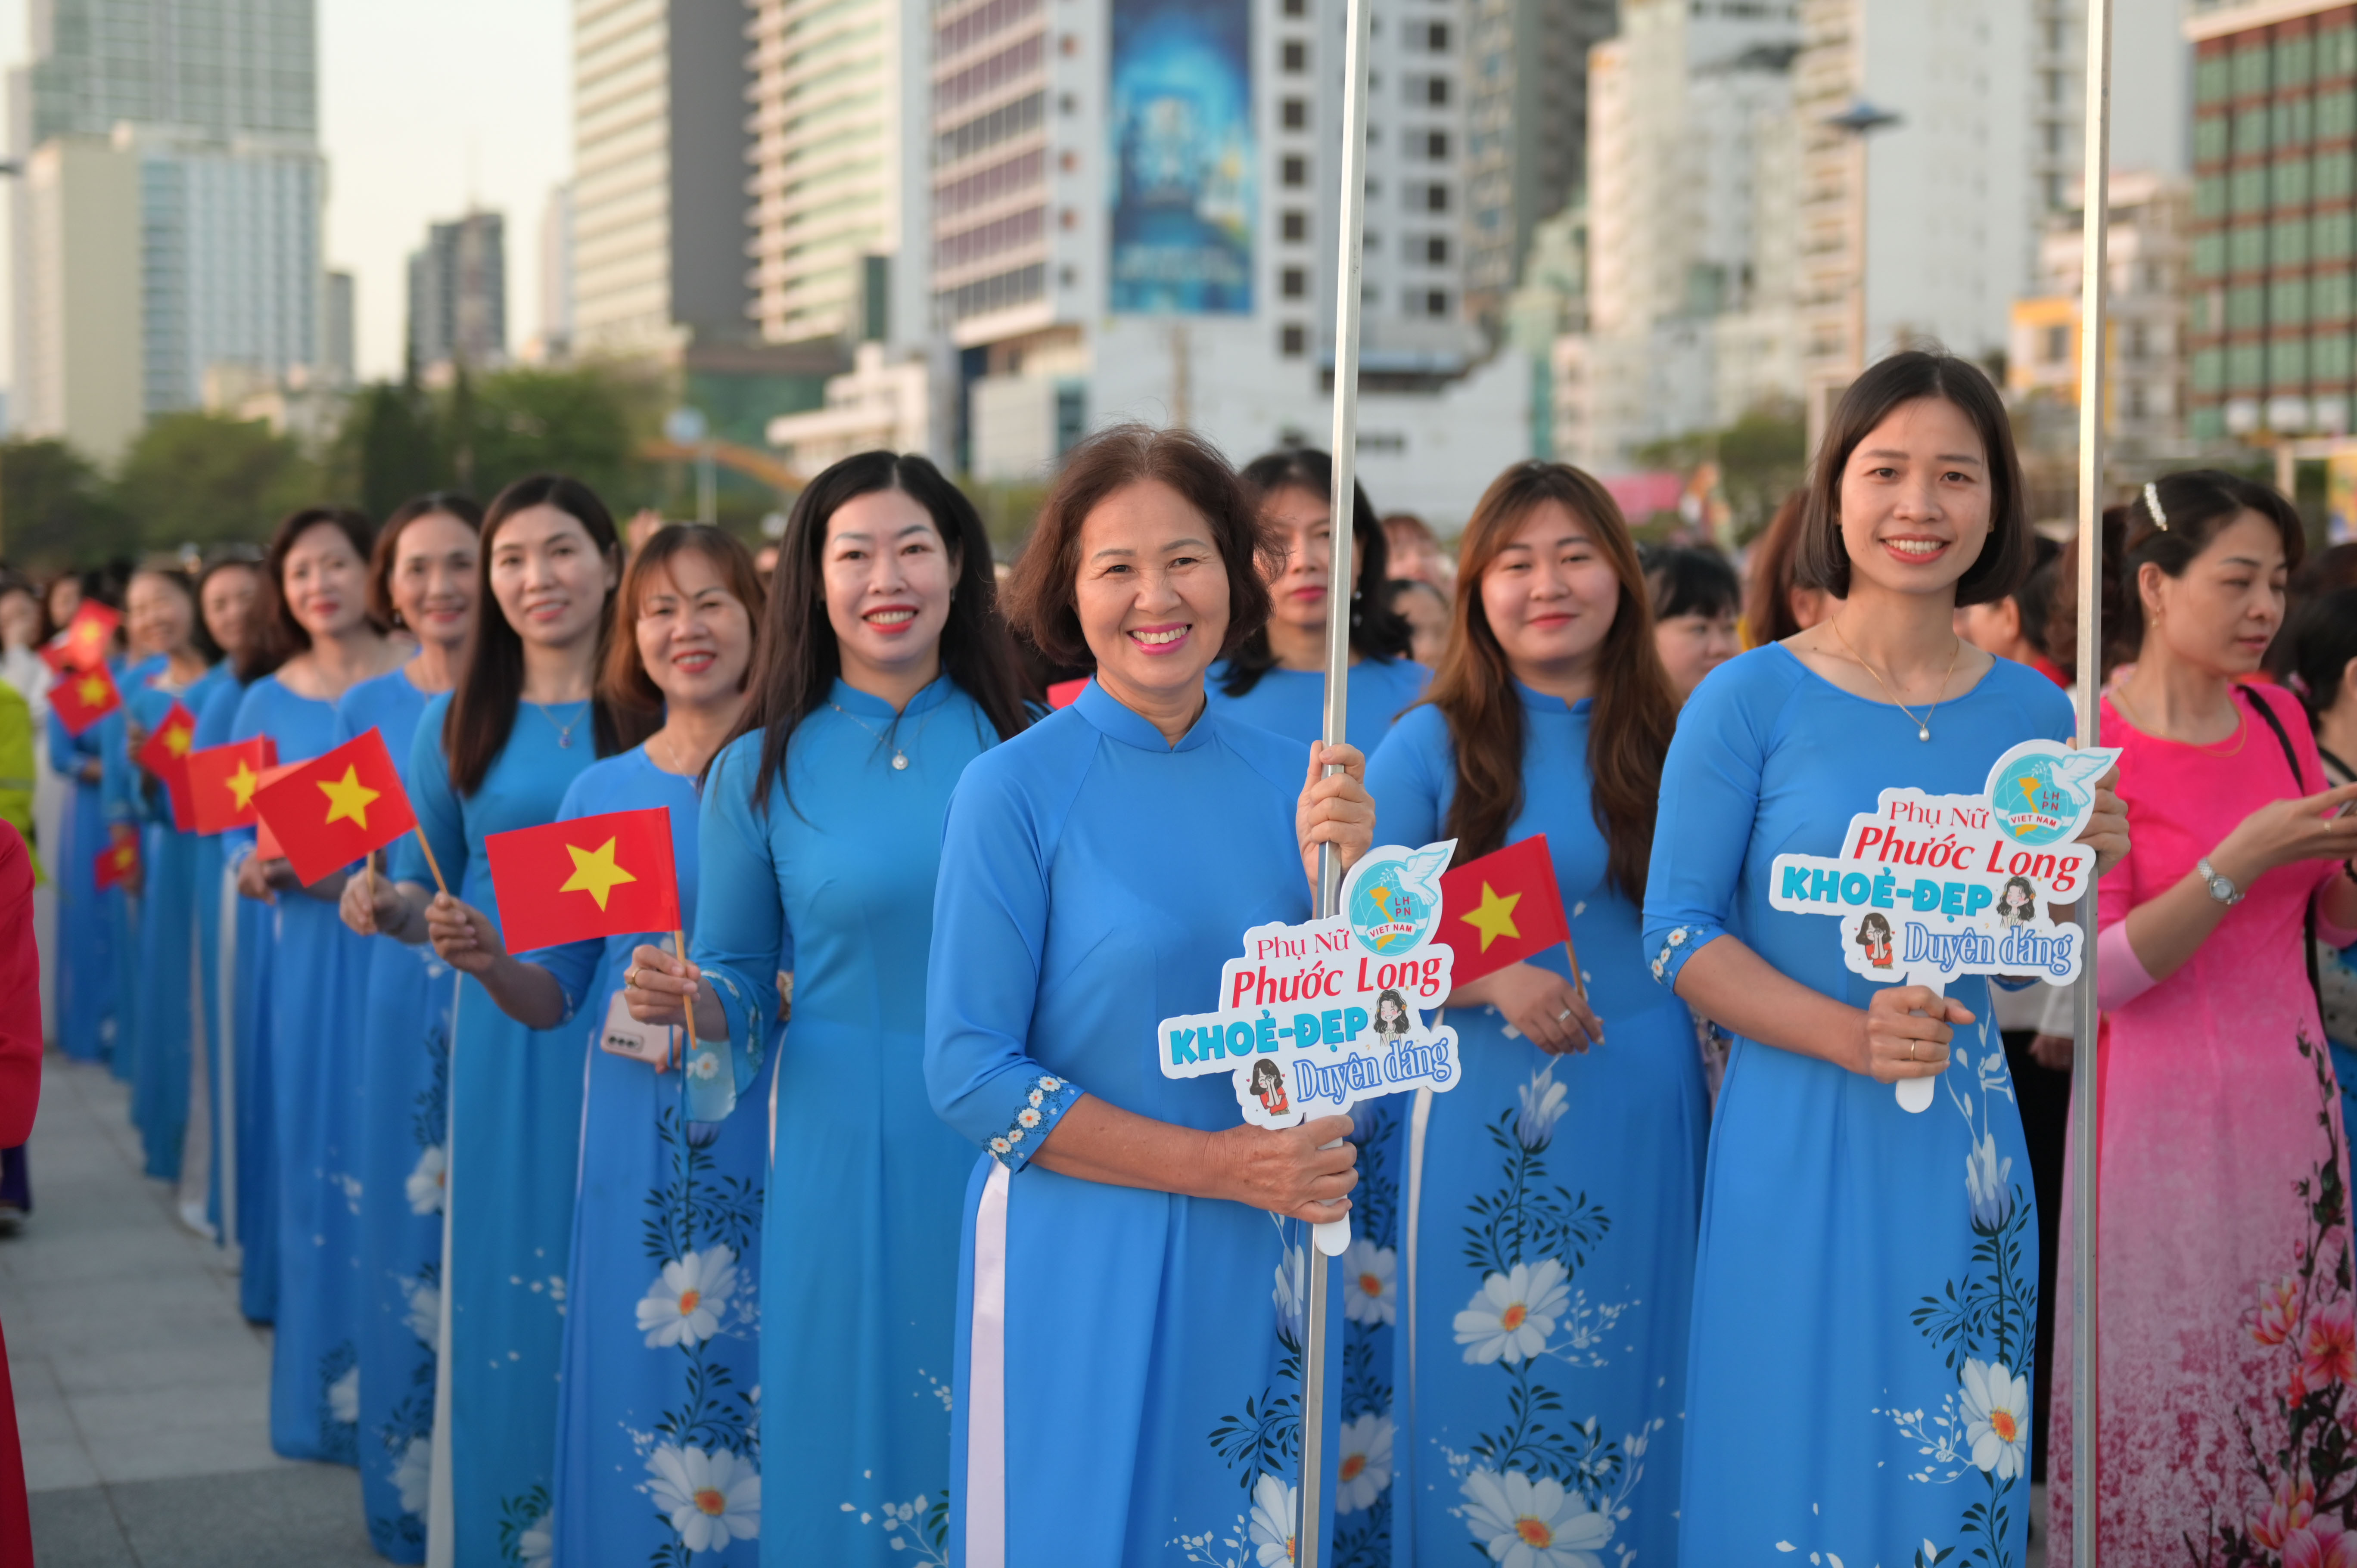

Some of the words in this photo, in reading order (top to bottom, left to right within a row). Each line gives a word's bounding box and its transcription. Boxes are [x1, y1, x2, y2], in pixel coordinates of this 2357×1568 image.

[1889, 801, 1941, 829] Phụ
[1950, 807, 1990, 830] Nữ
[2010, 814, 2033, 824] VIET
[2036, 815, 2057, 827] NAM
[1853, 826, 1975, 870] Phước
[1986, 840, 2083, 892] Long
[1257, 936, 1306, 961] Phụ
[1314, 928, 1350, 953] Nữ
[1369, 925, 1390, 938] VIET
[1393, 924, 1412, 933] NAM
[1903, 921, 1995, 973] Duyên
[1999, 924, 2073, 976] dáng
[1231, 959, 1344, 1009] Phước
[1356, 956, 1443, 997] Long
[1293, 1052, 1383, 1105] Duyên
[1384, 1037, 1450, 1084] dáng
